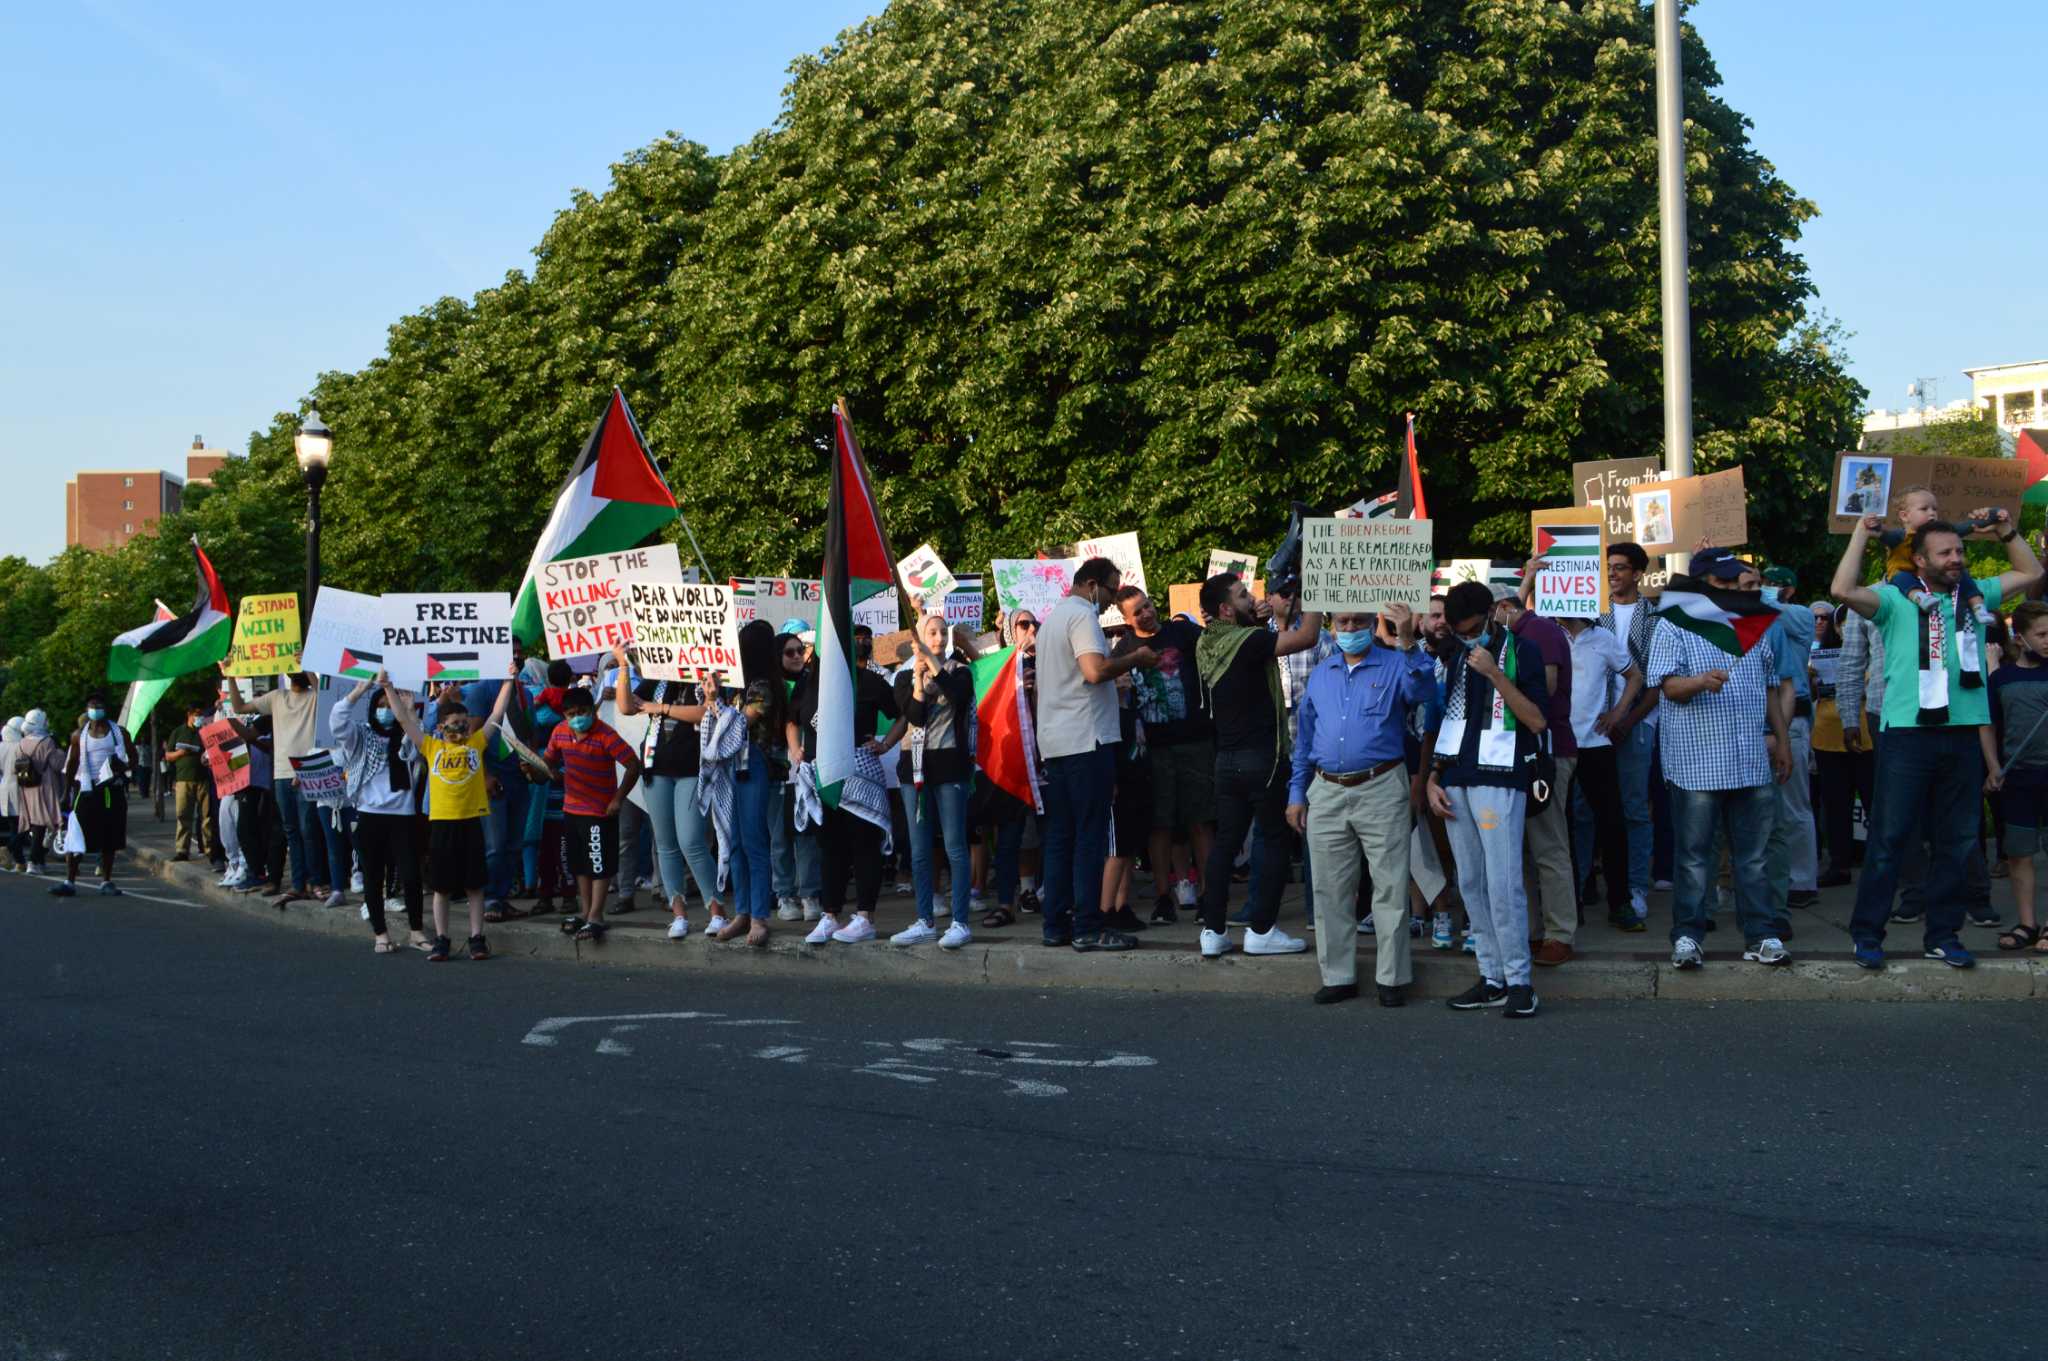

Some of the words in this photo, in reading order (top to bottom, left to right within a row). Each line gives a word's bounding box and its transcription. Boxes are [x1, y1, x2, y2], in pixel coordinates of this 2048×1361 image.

[1608, 470, 1640, 489] From
[1642, 467, 1662, 483] th
[1609, 489, 1633, 508] riv
[1312, 524, 1334, 538] THE
[1340, 524, 1371, 537] BIDEN
[1374, 524, 1412, 537] REGIME
[1608, 515, 1632, 535] the
[1308, 541, 1336, 554] WILL
[1340, 541, 1354, 554] BE
[1358, 542, 1432, 556] REMEMBERED
[544, 559, 599, 586] STOP
[608, 552, 648, 573] THE
[1305, 558, 1322, 570] AS
[1328, 558, 1338, 570] A
[1342, 558, 1366, 570] KEY
[1370, 558, 1432, 572] PARTICIPANT
[1537, 560, 1600, 572] LESTINIAN
[1307, 574, 1319, 586] IN
[1325, 573, 1346, 586] THE
[1350, 574, 1413, 586] MASSACRE
[1542, 576, 1596, 595] LIVES
[1642, 570, 1666, 588] ree
[546, 579, 622, 610] KILLING
[632, 584, 670, 606] DEAR
[672, 586, 728, 612] WORLD,
[761, 580, 786, 597] 73
[790, 581, 820, 602] YRS
[944, 594, 982, 604] PALESTINIAN
[1304, 588, 1320, 602] OF
[1324, 588, 1344, 602] THE
[1346, 588, 1421, 603] PALESTINIANS
[257, 598, 296, 614] STAND
[416, 602, 478, 621] FREE
[546, 605, 597, 633] STOP
[604, 597, 632, 617] TH
[736, 608, 756, 620] IVE
[948, 606, 980, 618] LIVES
[1540, 598, 1597, 613] MATTER
[634, 608, 653, 624] WE
[656, 608, 669, 624] DO
[671, 610, 692, 624] NOT
[694, 610, 725, 625] NEED
[854, 610, 872, 625] AVE
[874, 609, 897, 624] THE
[241, 618, 284, 638] WITH
[382, 626, 510, 646] PALESTINE
[636, 625, 698, 648] SYMPATHY,
[700, 626, 722, 646] WE
[557, 621, 634, 655] HATE!!
[232, 641, 300, 662] PALESTINE
[639, 646, 673, 664] NEED
[678, 646, 736, 666] ACTION
[302, 776, 340, 790] LIVES
[588, 825, 603, 874] adidas
